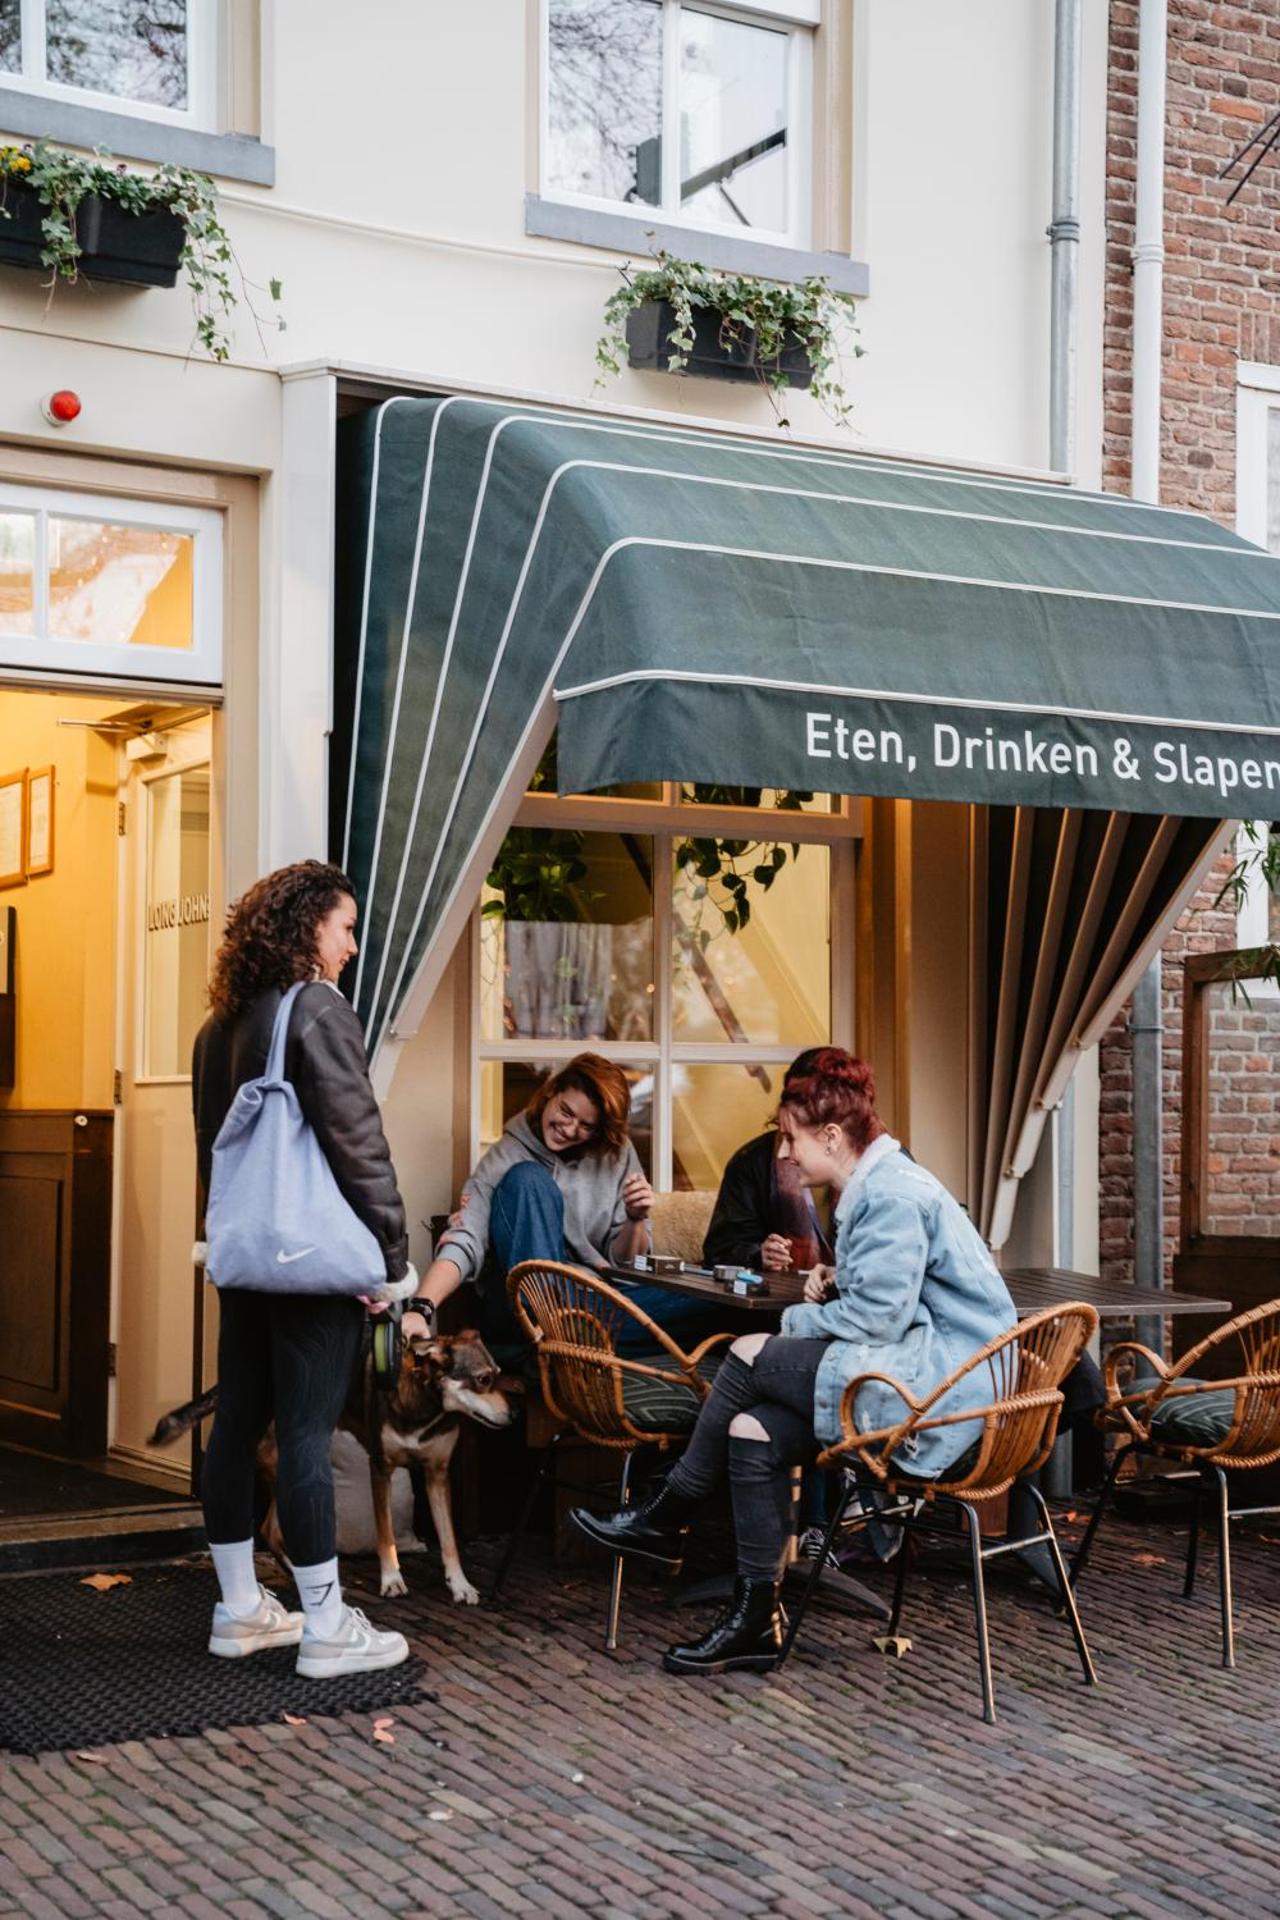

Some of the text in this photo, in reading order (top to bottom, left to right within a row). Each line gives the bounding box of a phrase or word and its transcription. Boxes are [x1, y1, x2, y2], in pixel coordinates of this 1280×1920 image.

[805, 711, 1280, 797] Eten, Drinken & Slapen
[148, 894, 209, 932] LONG JOHN
